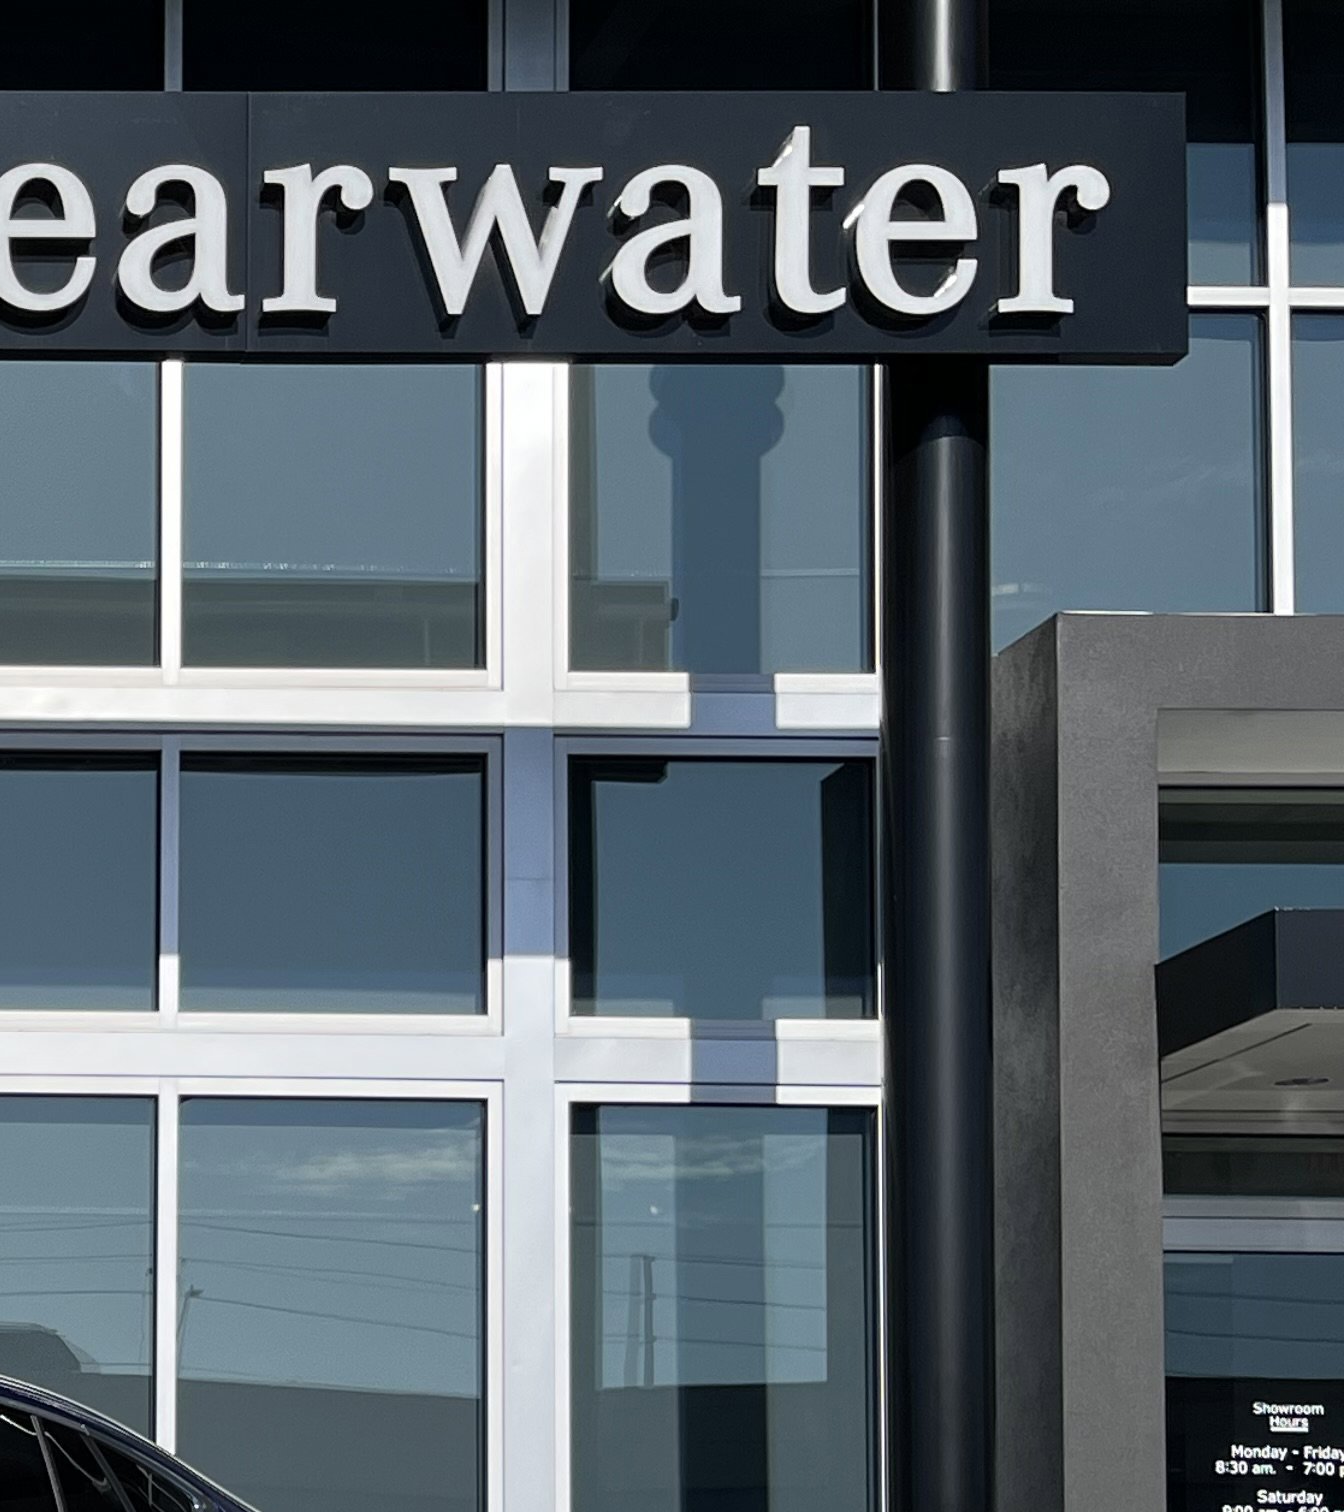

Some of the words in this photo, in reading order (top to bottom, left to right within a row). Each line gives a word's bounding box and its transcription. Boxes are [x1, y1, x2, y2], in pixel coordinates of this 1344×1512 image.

[1252, 1401, 1325, 1415] Showroom
[1269, 1416, 1309, 1429] Hours
[1231, 1444, 1288, 1461] Monday
[1303, 1445, 1344, 1462] Friday
[1215, 1460, 1248, 1475] 8:30
[1303, 1461, 1335, 1476] 7:00
[1256, 1489, 1324, 1506] Saturday
